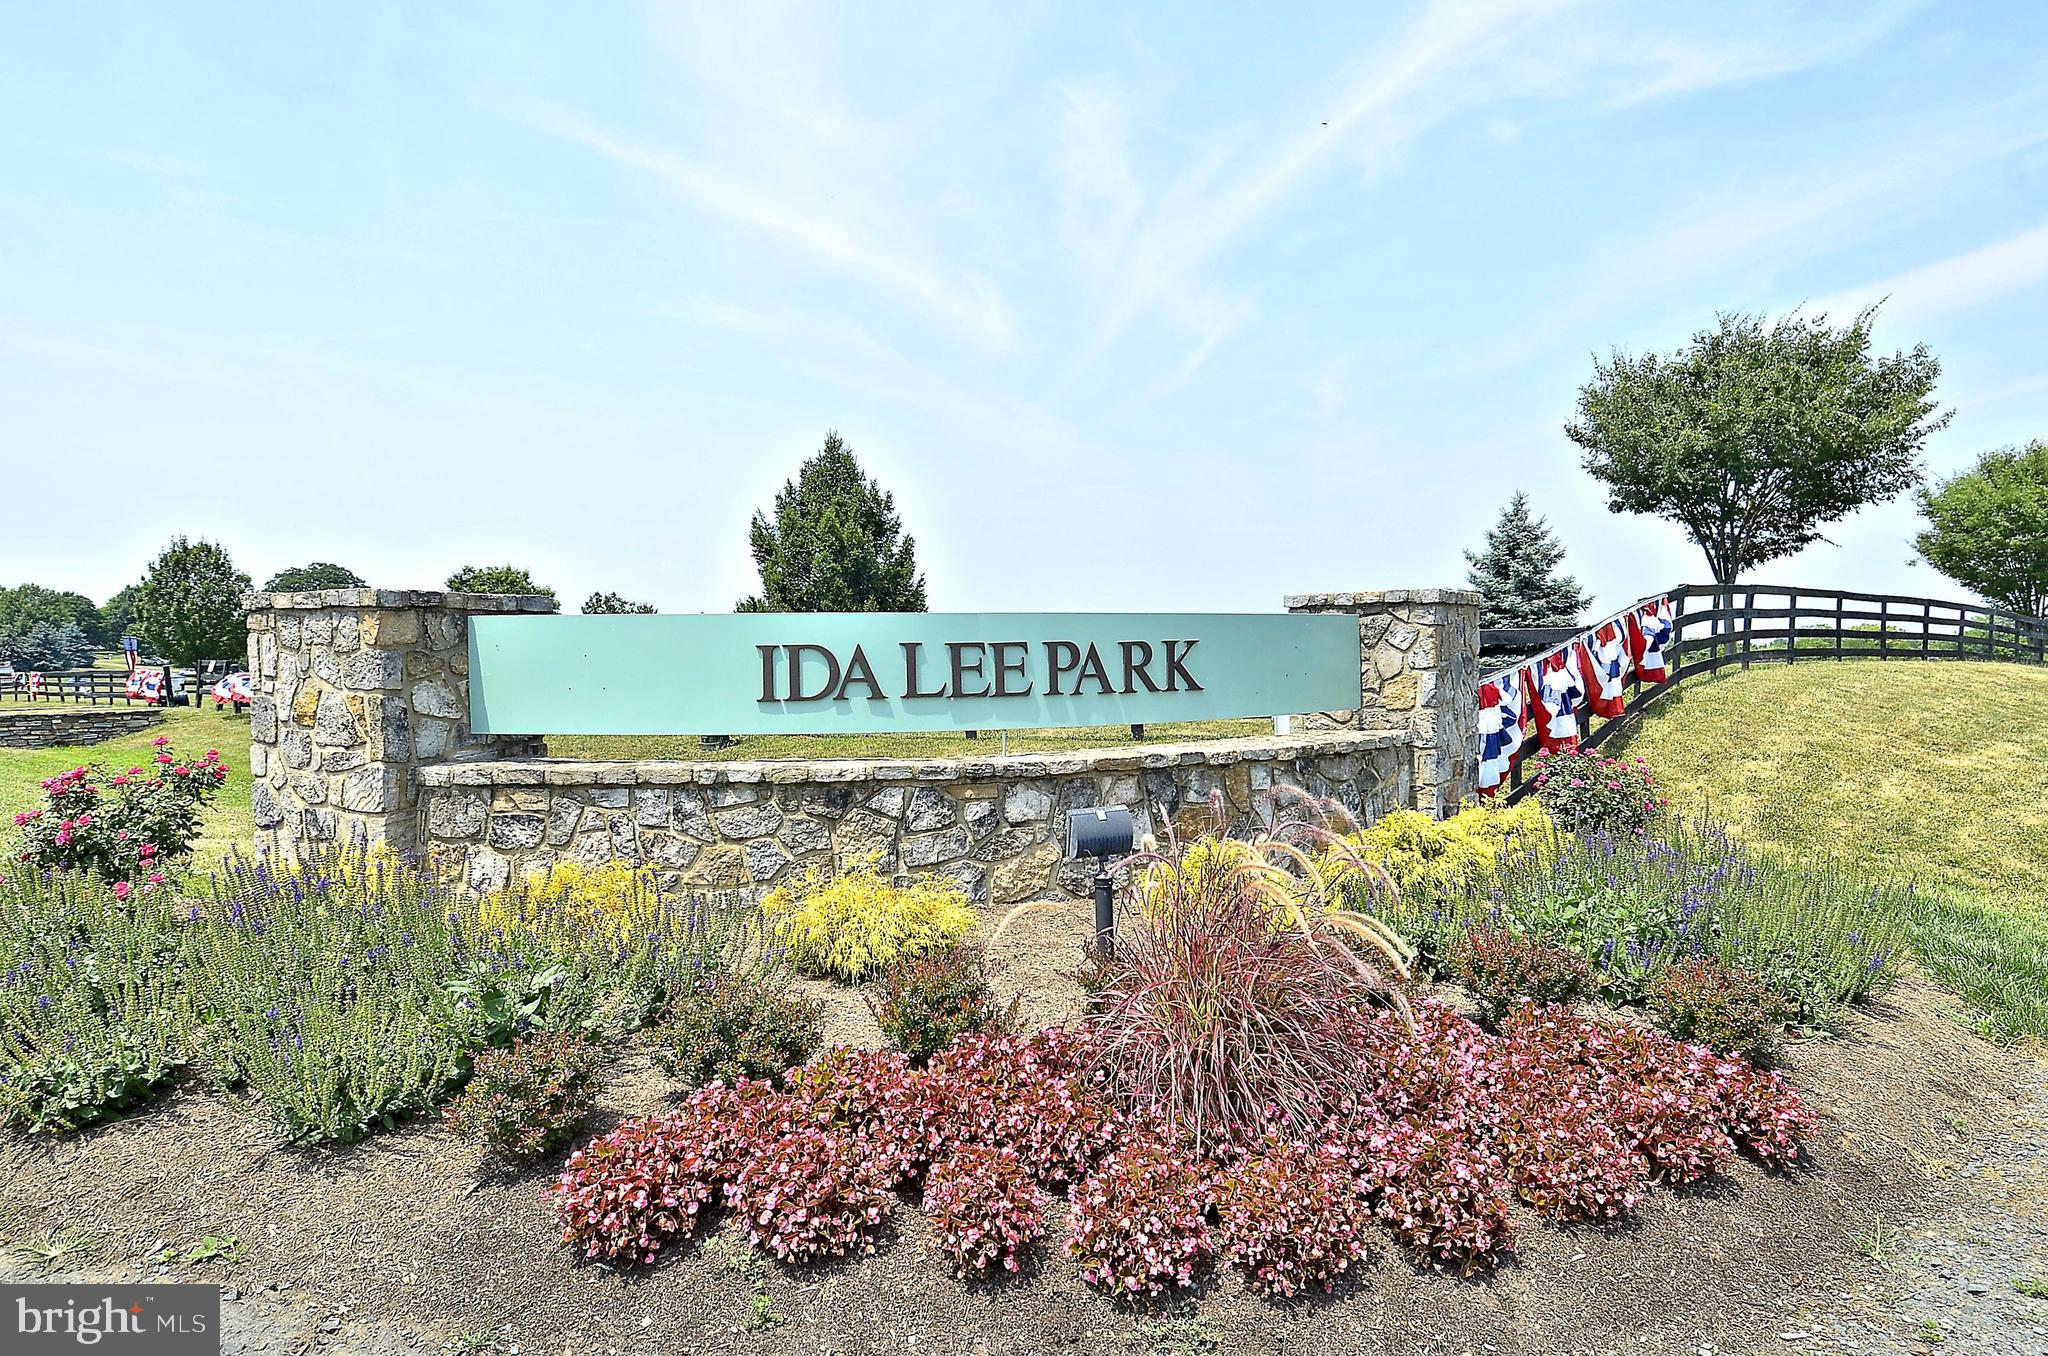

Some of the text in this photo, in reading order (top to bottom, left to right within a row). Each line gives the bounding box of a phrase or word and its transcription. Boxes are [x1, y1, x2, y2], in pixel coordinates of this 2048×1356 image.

[756, 639, 1205, 703] IDA LEE PARK
